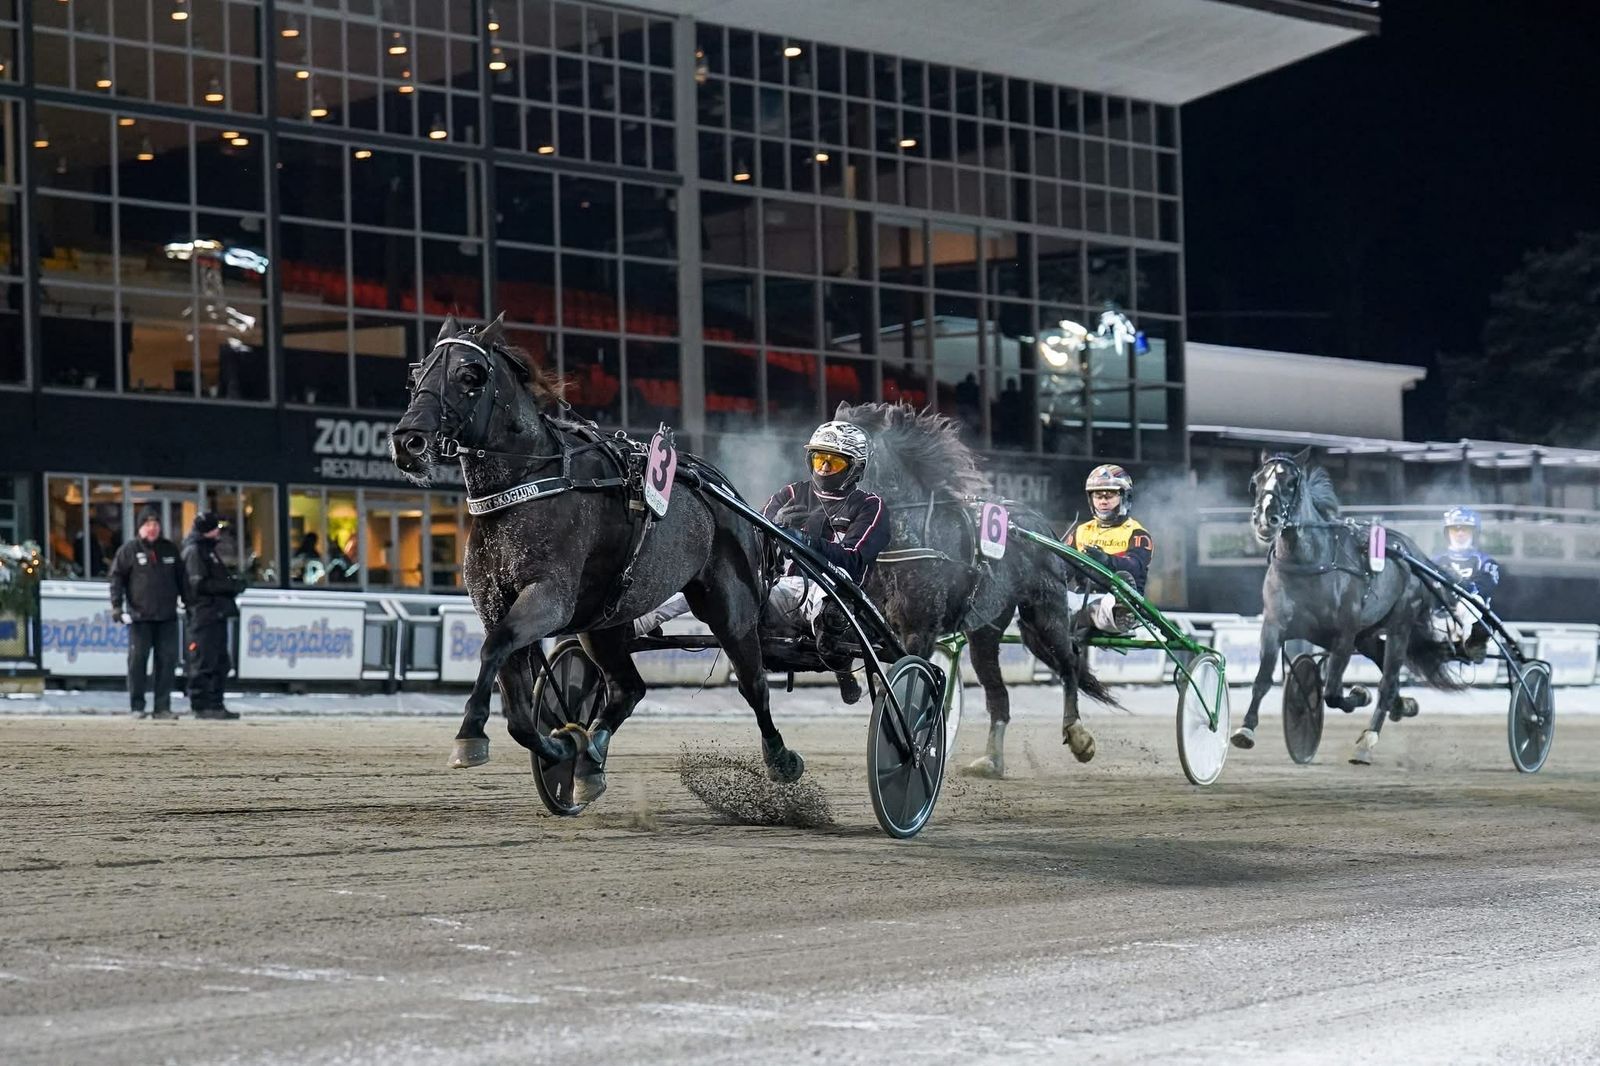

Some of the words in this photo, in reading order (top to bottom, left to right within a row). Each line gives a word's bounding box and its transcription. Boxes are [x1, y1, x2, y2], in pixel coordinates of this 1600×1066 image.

[652, 439, 672, 492] 3
[494, 484, 539, 507] SKOGLUND
[987, 506, 1002, 543] 6
